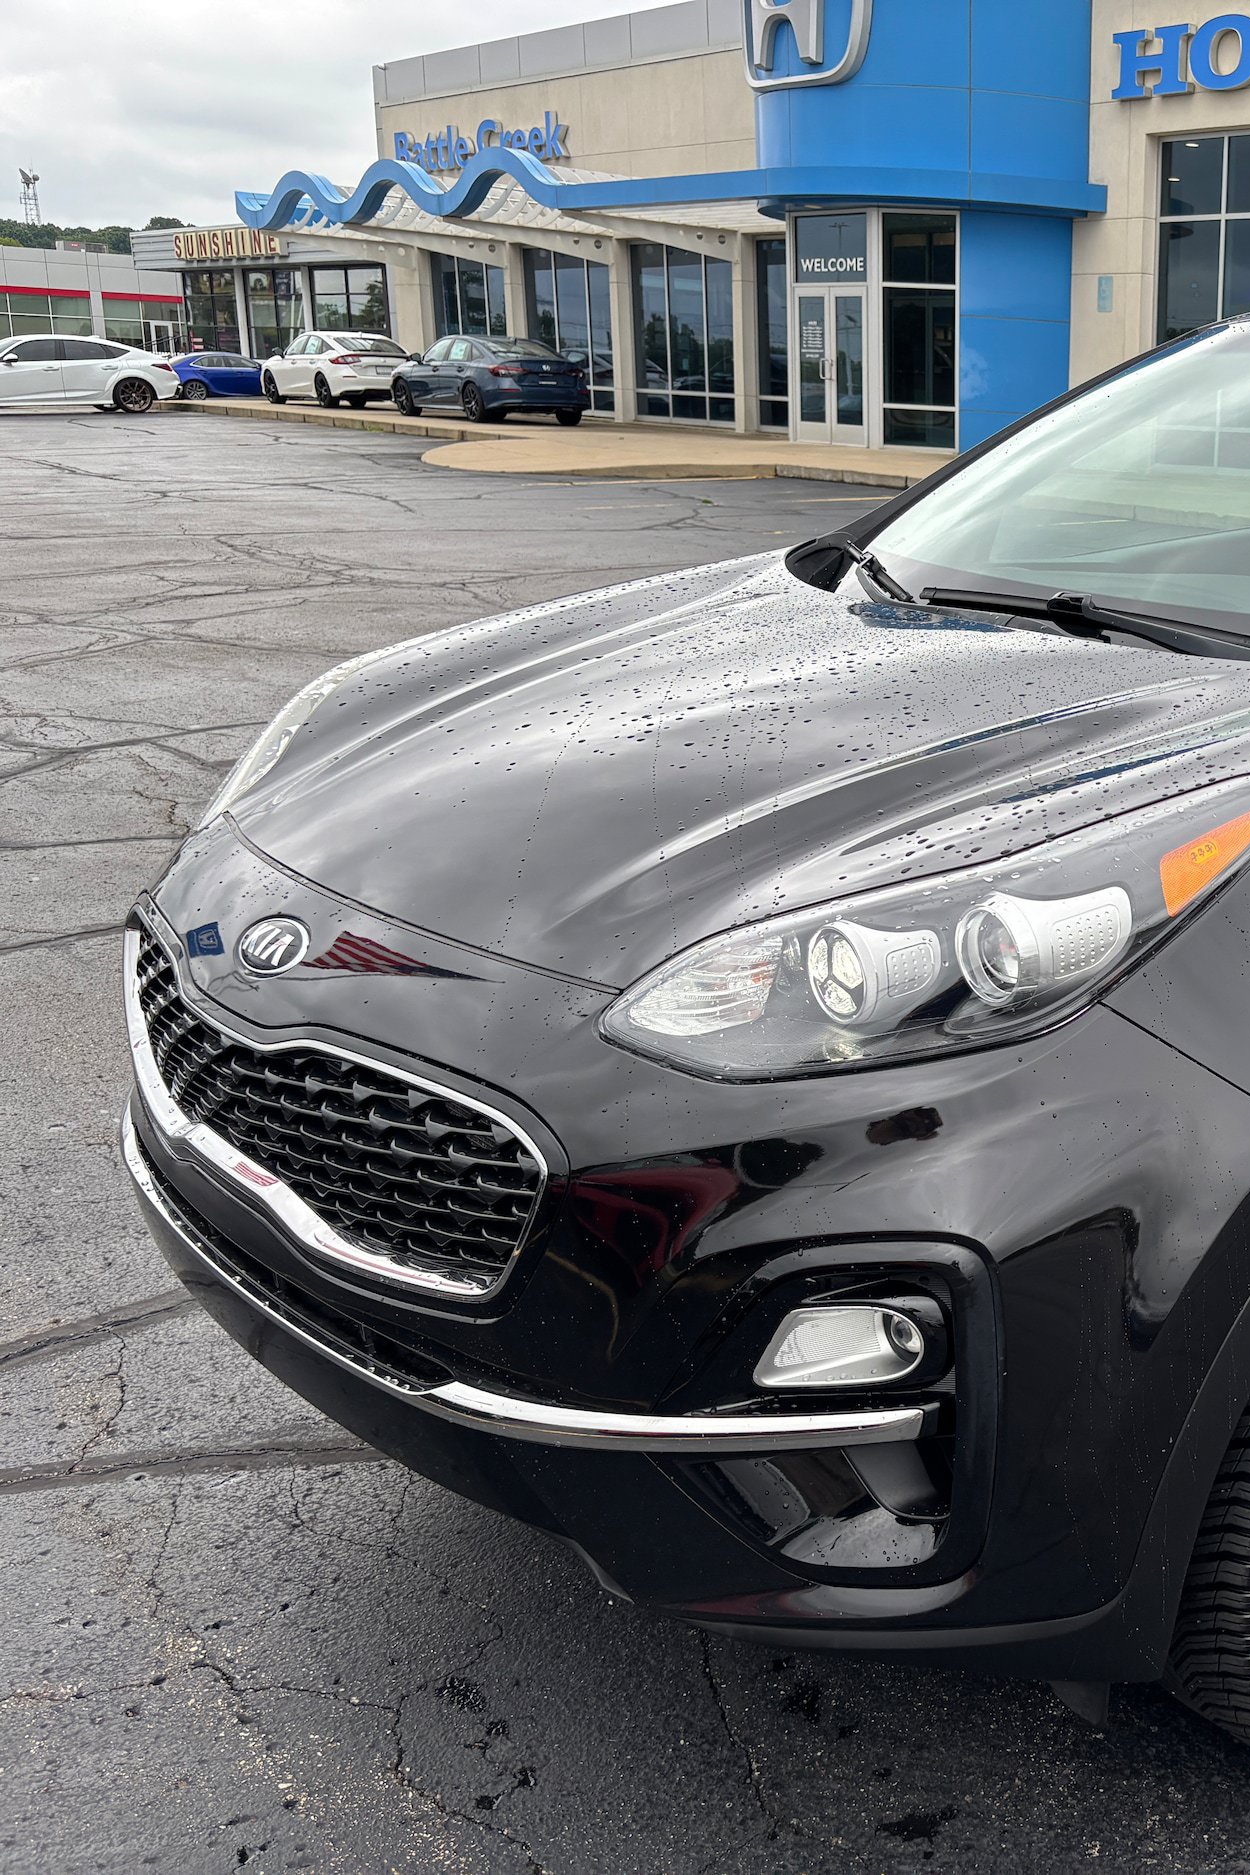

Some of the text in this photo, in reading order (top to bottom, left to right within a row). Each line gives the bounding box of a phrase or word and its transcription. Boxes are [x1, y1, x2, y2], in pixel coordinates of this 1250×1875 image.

[394, 111, 567, 171] Battle Creek
[174, 229, 277, 257] SUNSHINE
[801, 257, 865, 272] WELCOME
[242, 922, 295, 967] KIA
